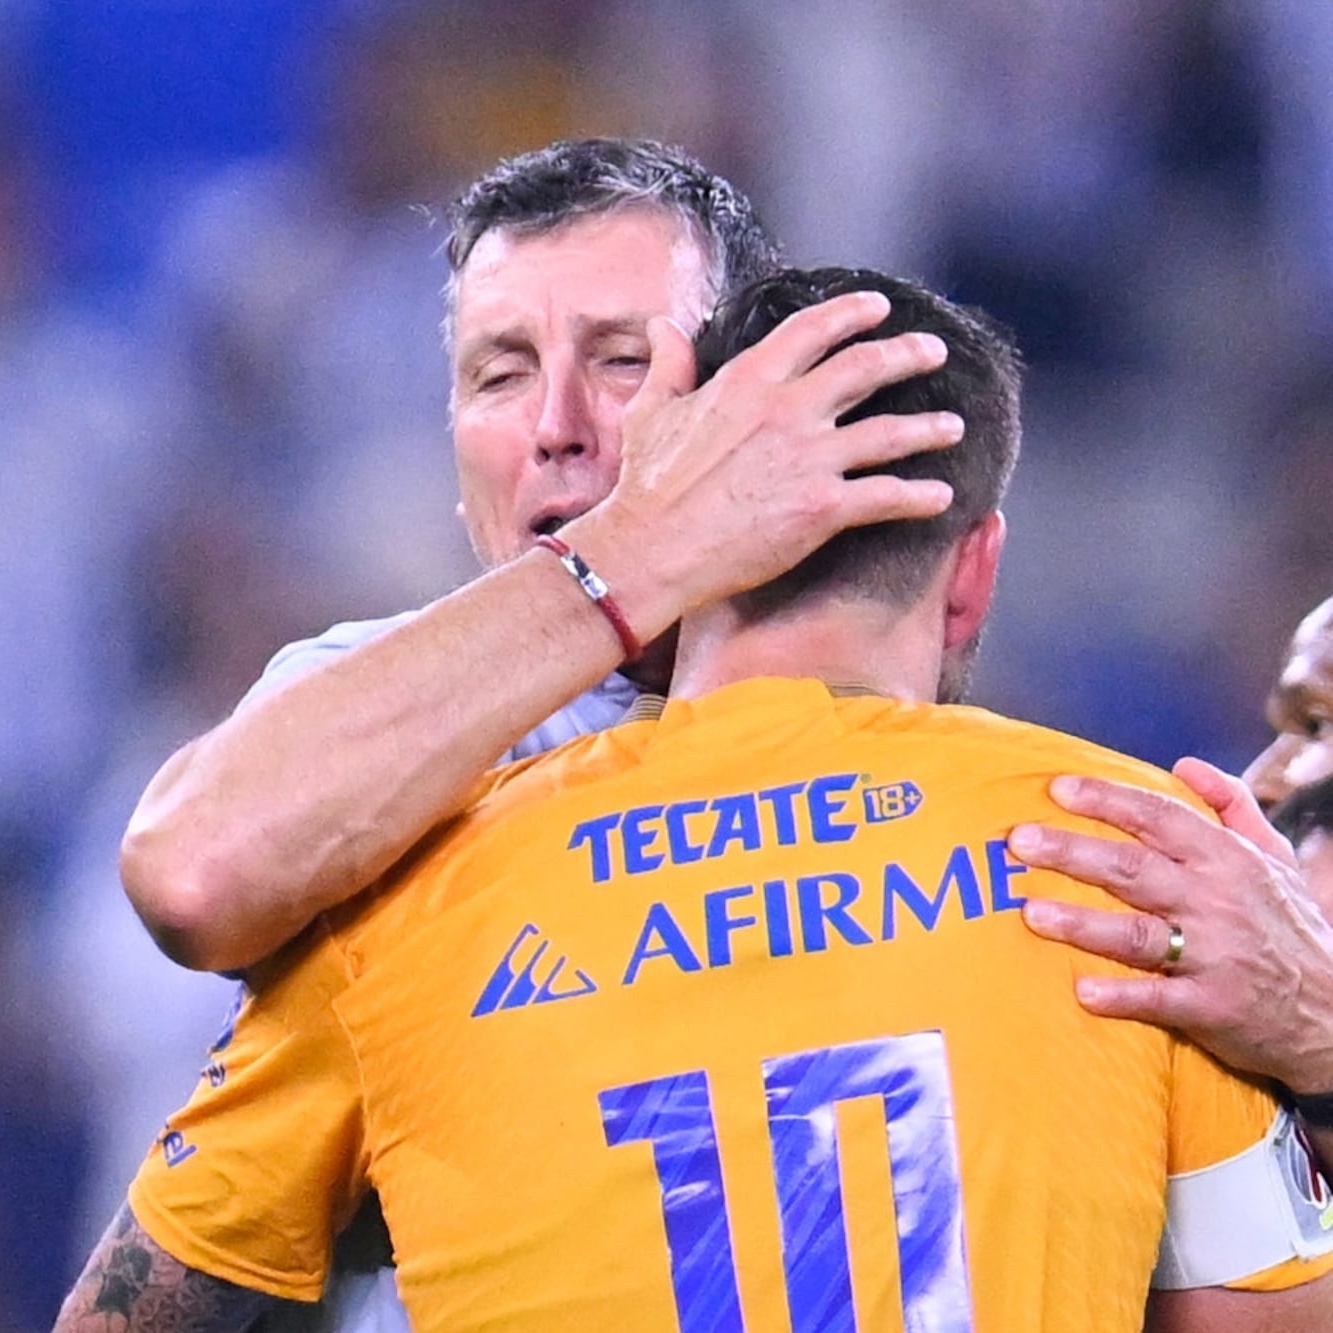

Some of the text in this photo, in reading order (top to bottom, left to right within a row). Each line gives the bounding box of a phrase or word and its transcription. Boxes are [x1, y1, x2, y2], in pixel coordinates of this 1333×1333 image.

[567, 774, 923, 883] TECATE 18+
[622, 840, 1030, 985] AFIRME
